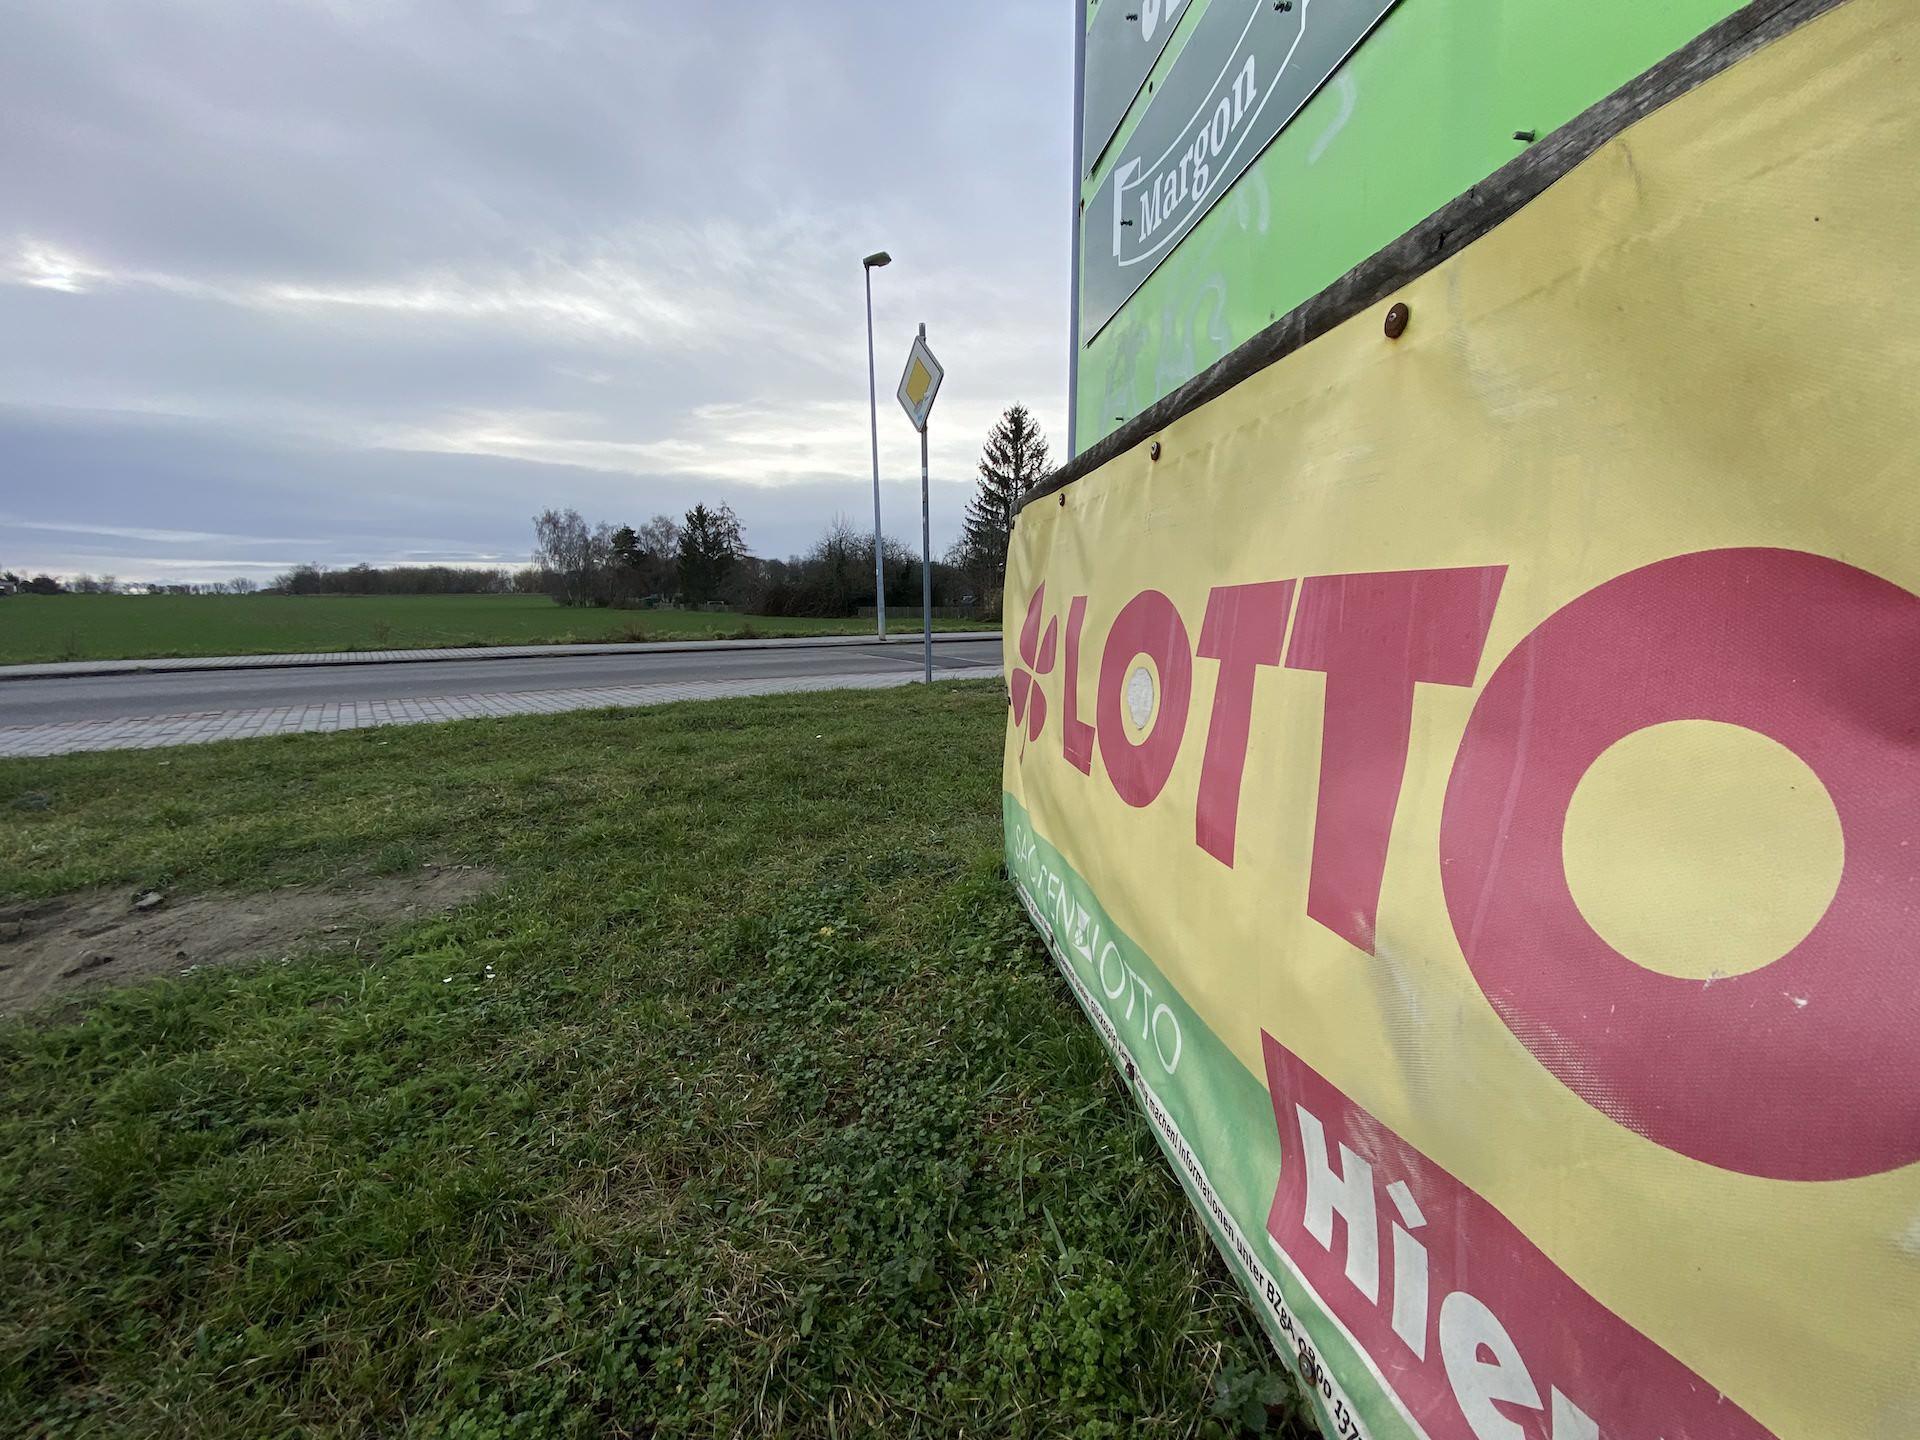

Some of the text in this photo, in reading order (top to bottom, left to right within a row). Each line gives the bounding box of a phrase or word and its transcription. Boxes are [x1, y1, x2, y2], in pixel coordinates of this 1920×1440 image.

[1137, 54, 1257, 243] Margon
[1063, 547, 1920, 1181] LOTTO
[1149, 1096, 1179, 1149] machen!
[1178, 1139, 1236, 1243] Informationen
[1236, 1238, 1265, 1287] unter
[1266, 1282, 1296, 1341] BZgA
[1334, 1399, 1362, 1440] 137
